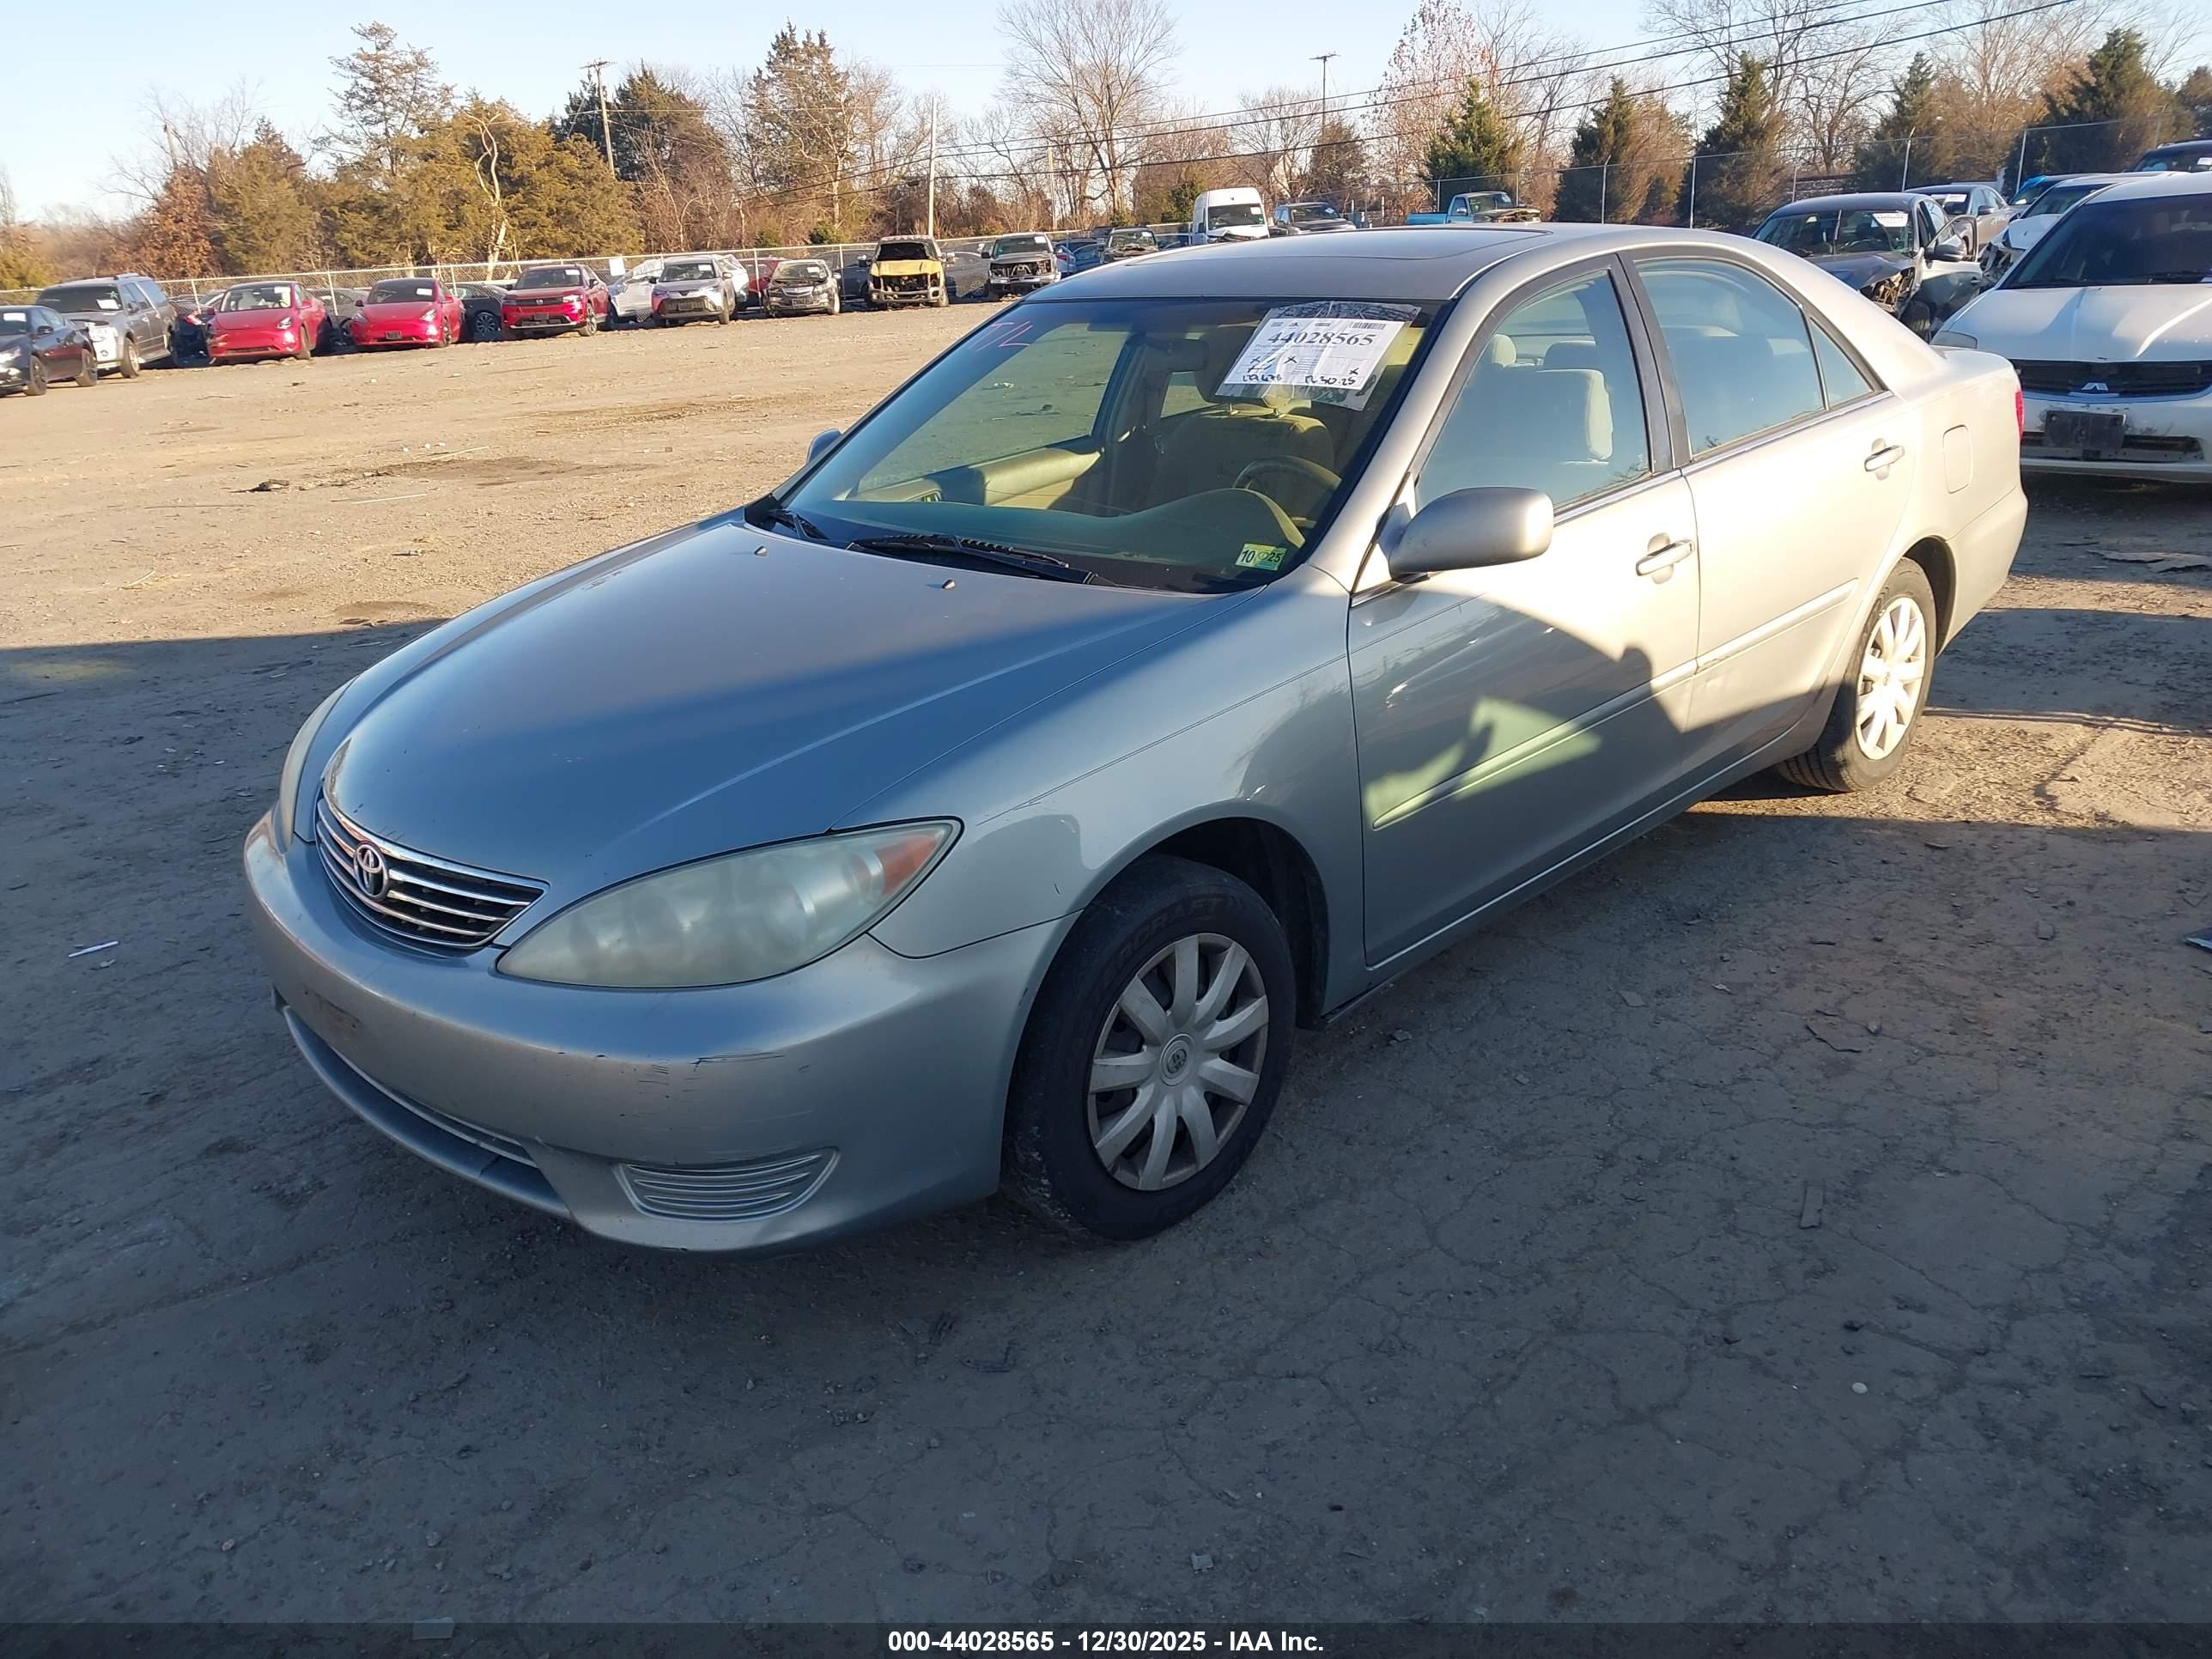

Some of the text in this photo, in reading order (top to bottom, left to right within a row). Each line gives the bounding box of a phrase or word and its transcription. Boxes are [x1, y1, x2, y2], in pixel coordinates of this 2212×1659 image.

[1267, 331, 1376, 346] 44028565
[1241, 550, 1283, 563] 10 25
